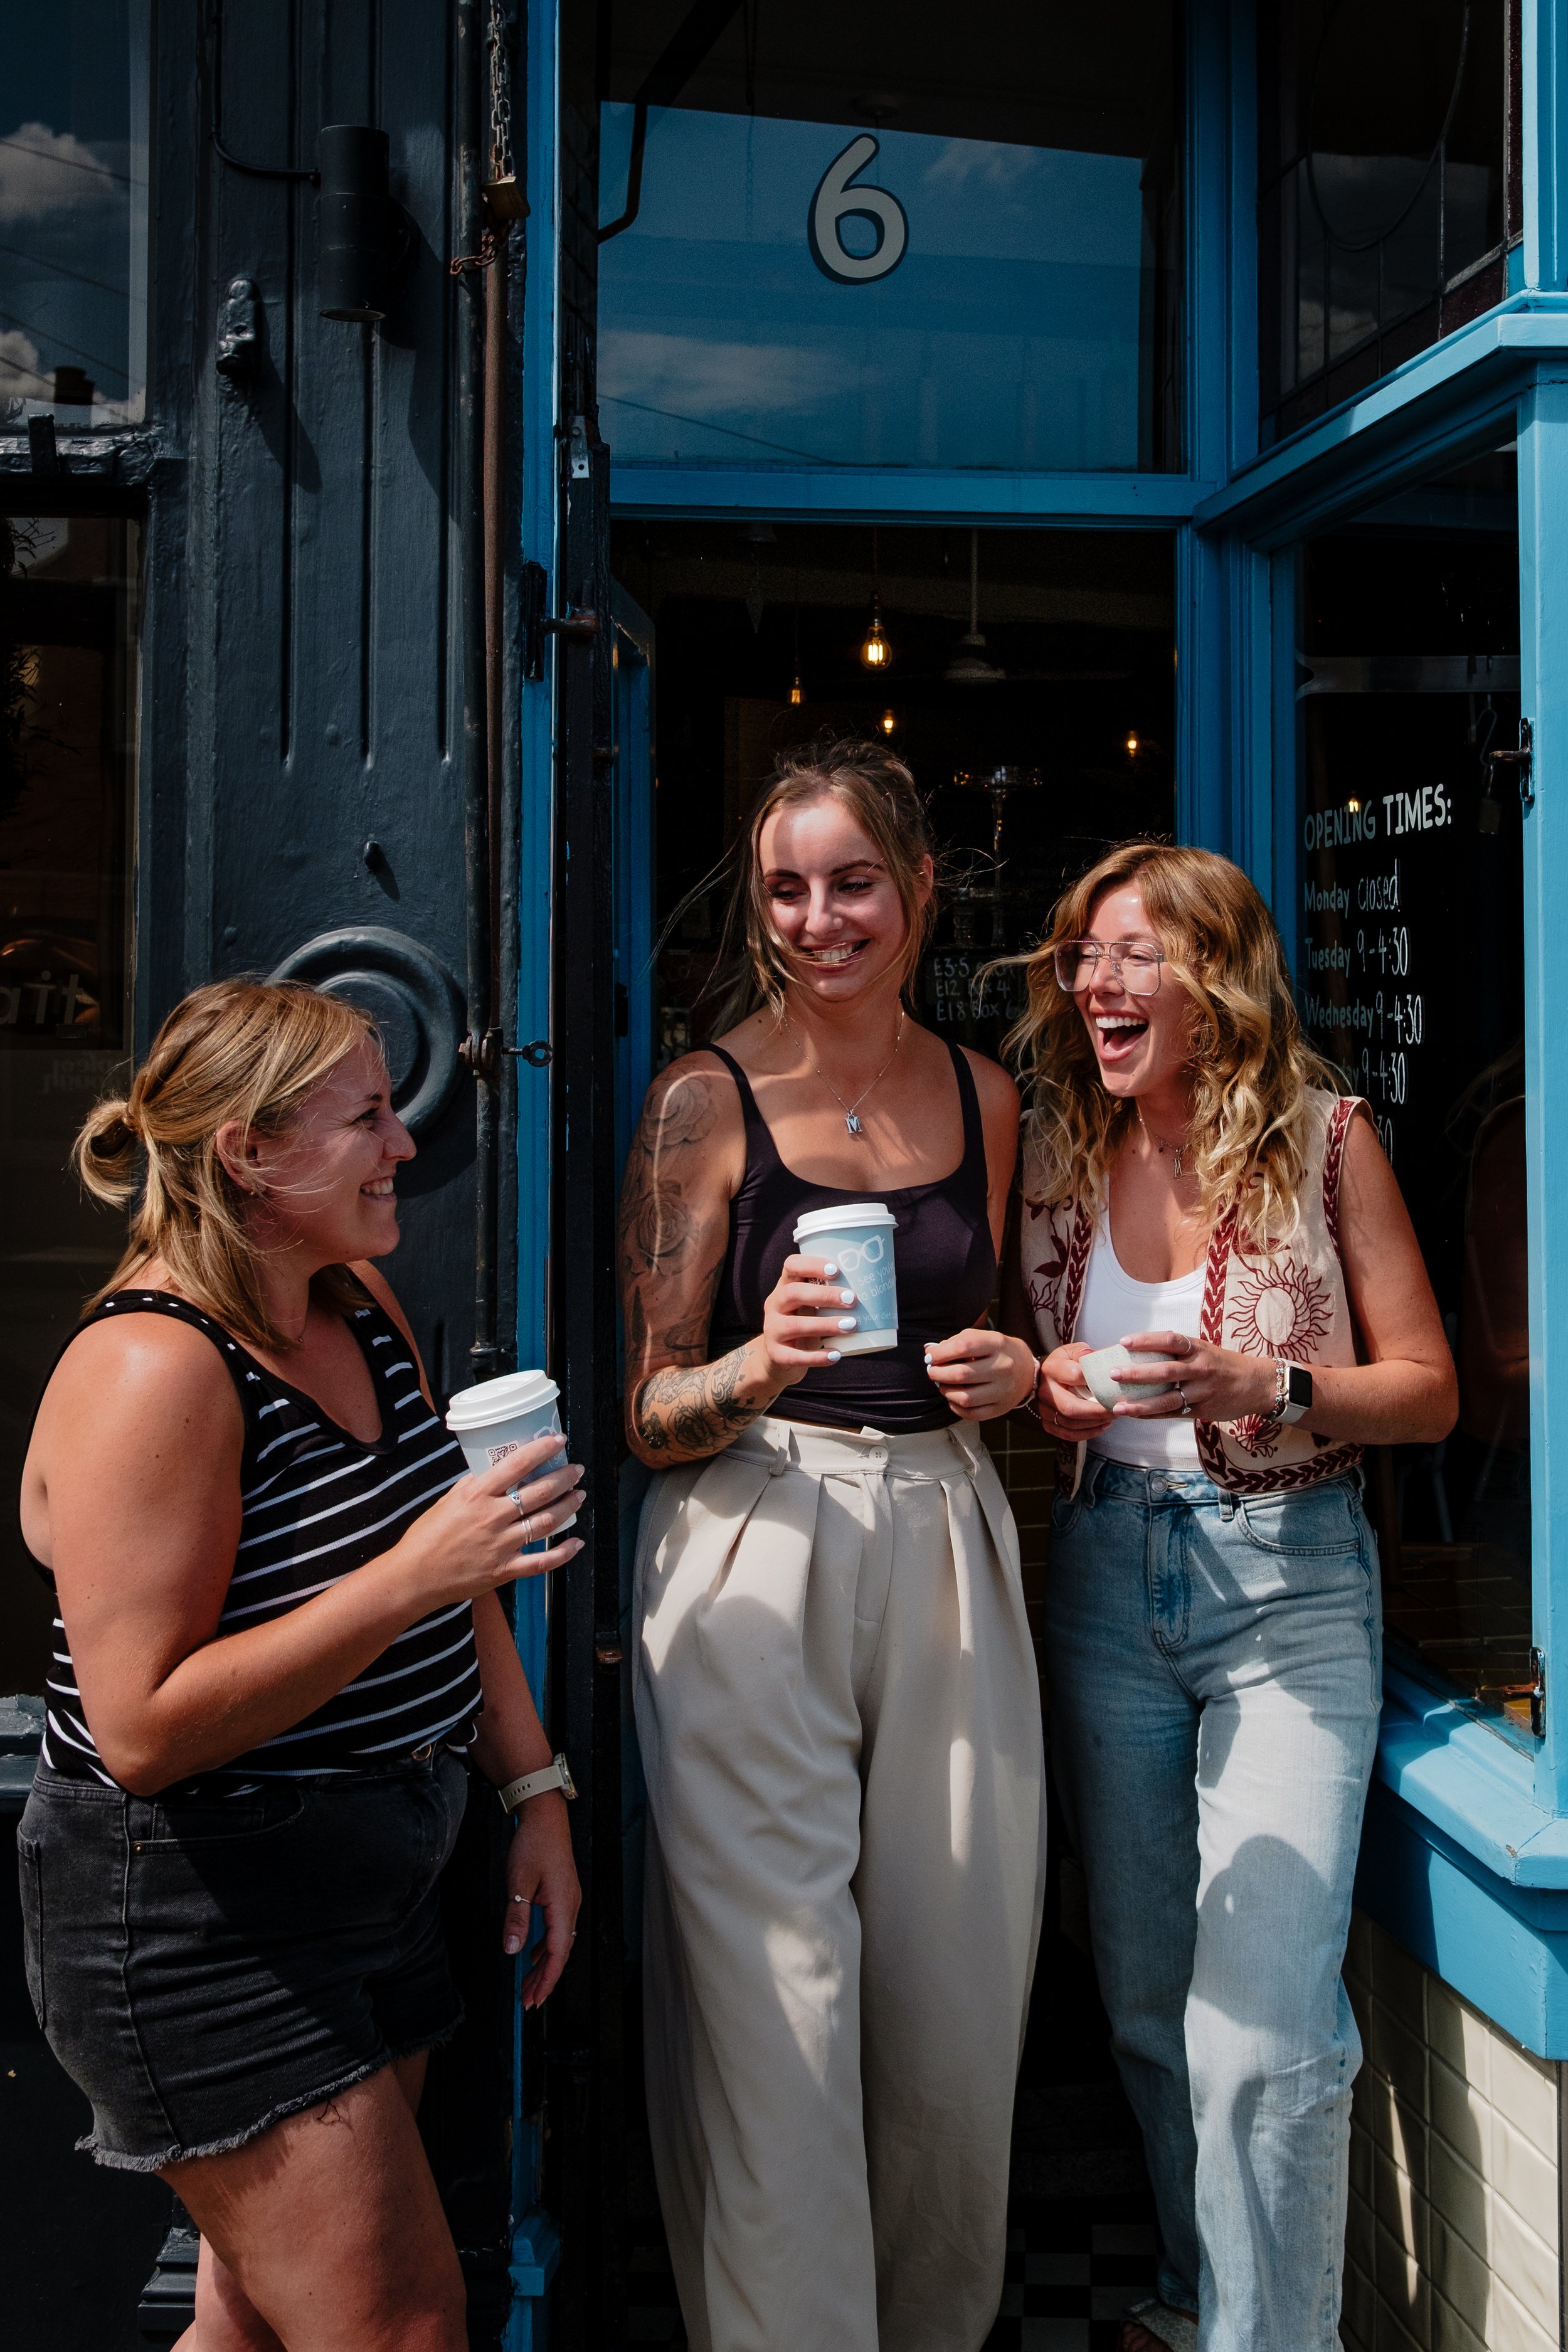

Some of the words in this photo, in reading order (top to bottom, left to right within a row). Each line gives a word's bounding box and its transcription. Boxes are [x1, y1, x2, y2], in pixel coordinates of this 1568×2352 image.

[807, 133, 909, 285] 6
[1304, 800, 1376, 852] OPENING
[1382, 783, 1452, 837] TIMES:
[1304, 880, 1350, 920] Monday
[1305, 940, 1350, 978] Tuesday
[1305, 993, 1374, 1038] Wednesday
[863, 1313, 879, 1325] your
